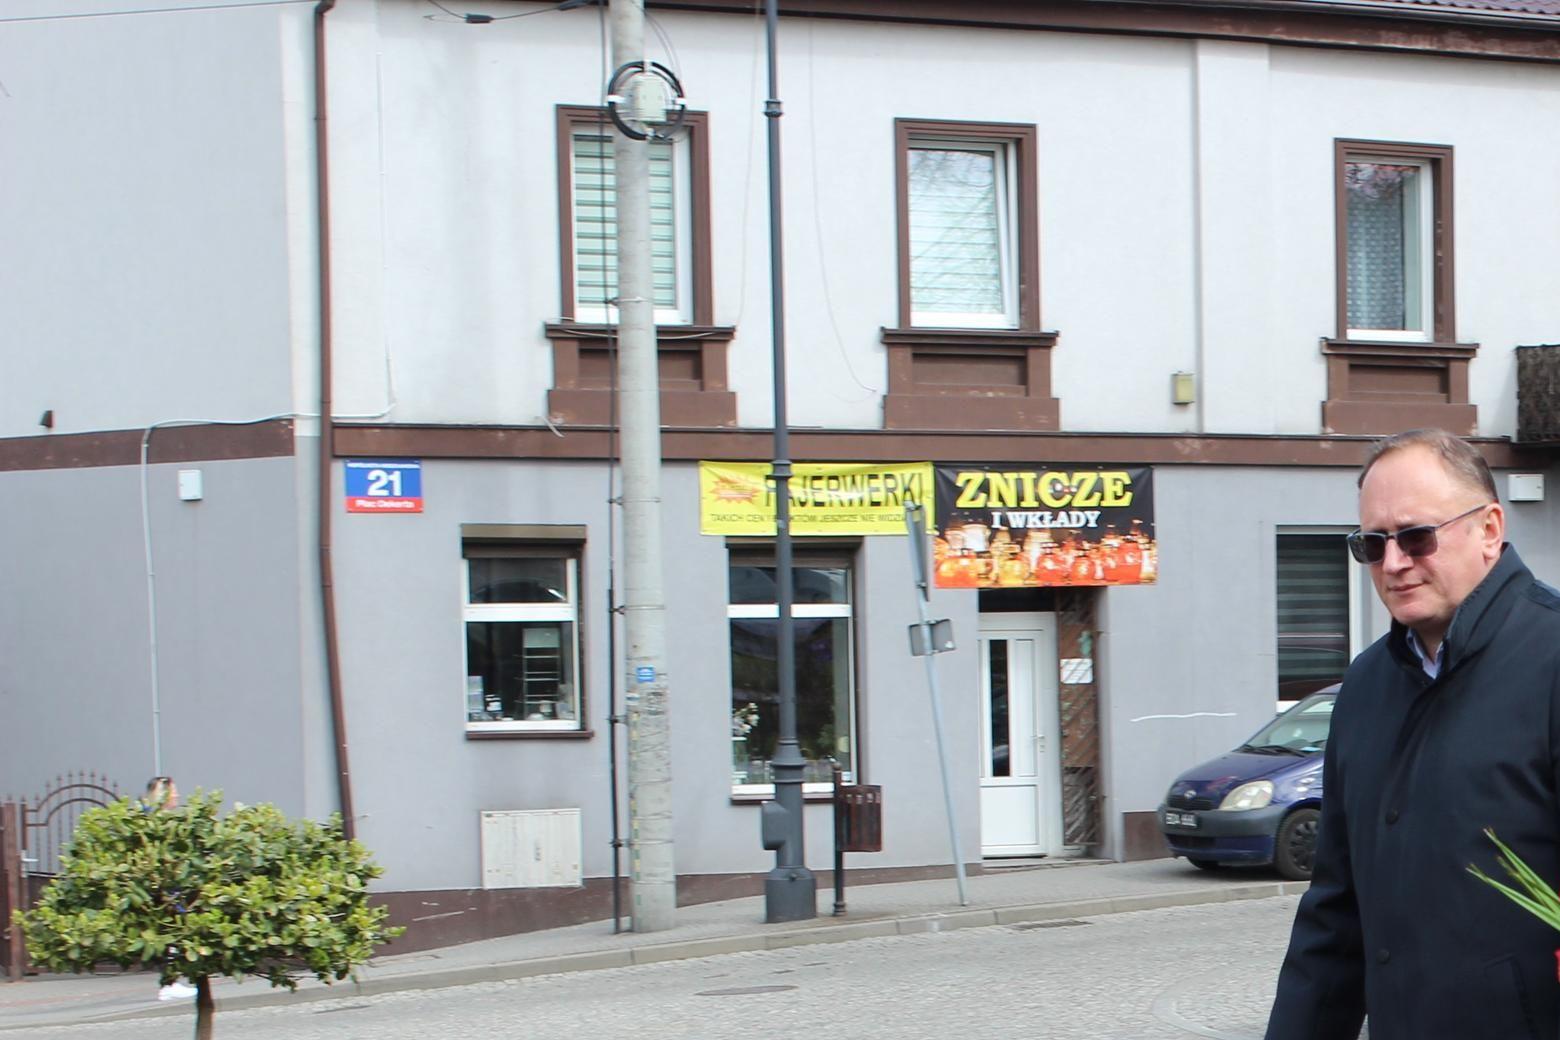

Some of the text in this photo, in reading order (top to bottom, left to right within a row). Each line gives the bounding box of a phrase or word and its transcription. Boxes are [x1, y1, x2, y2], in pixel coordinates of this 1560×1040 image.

[367, 469, 402, 496] 21
[956, 471, 1132, 508] ZNICZE
[991, 511, 1101, 529] I WKŁADY
